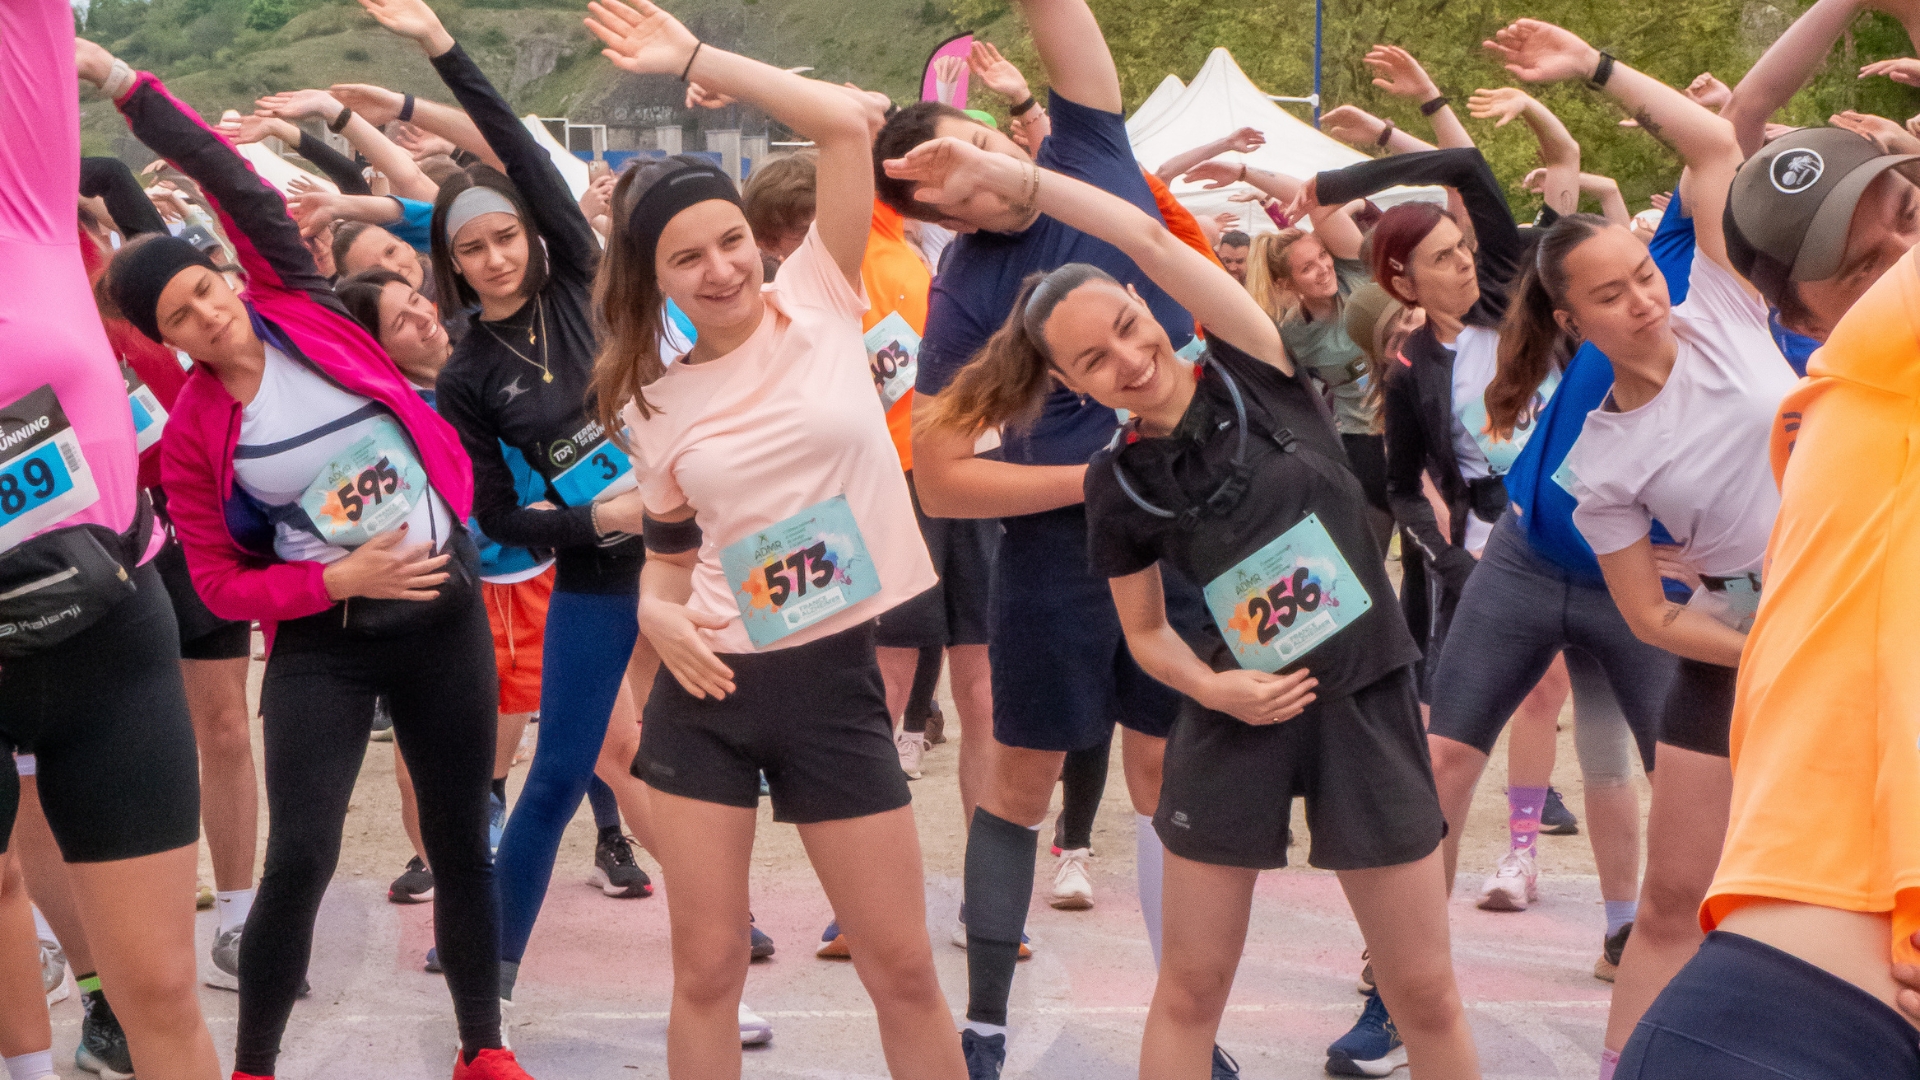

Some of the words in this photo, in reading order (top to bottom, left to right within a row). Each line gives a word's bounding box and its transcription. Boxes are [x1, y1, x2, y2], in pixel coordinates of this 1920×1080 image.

[572, 420, 597, 444] TERRE
[553, 445, 573, 463] TDR
[591, 452, 618, 480] 3
[337, 456, 398, 522] 595
[754, 540, 783, 560] ADMR
[764, 540, 834, 606] 573
[1235, 573, 1262, 595] ADMR
[1248, 567, 1321, 645] 256
